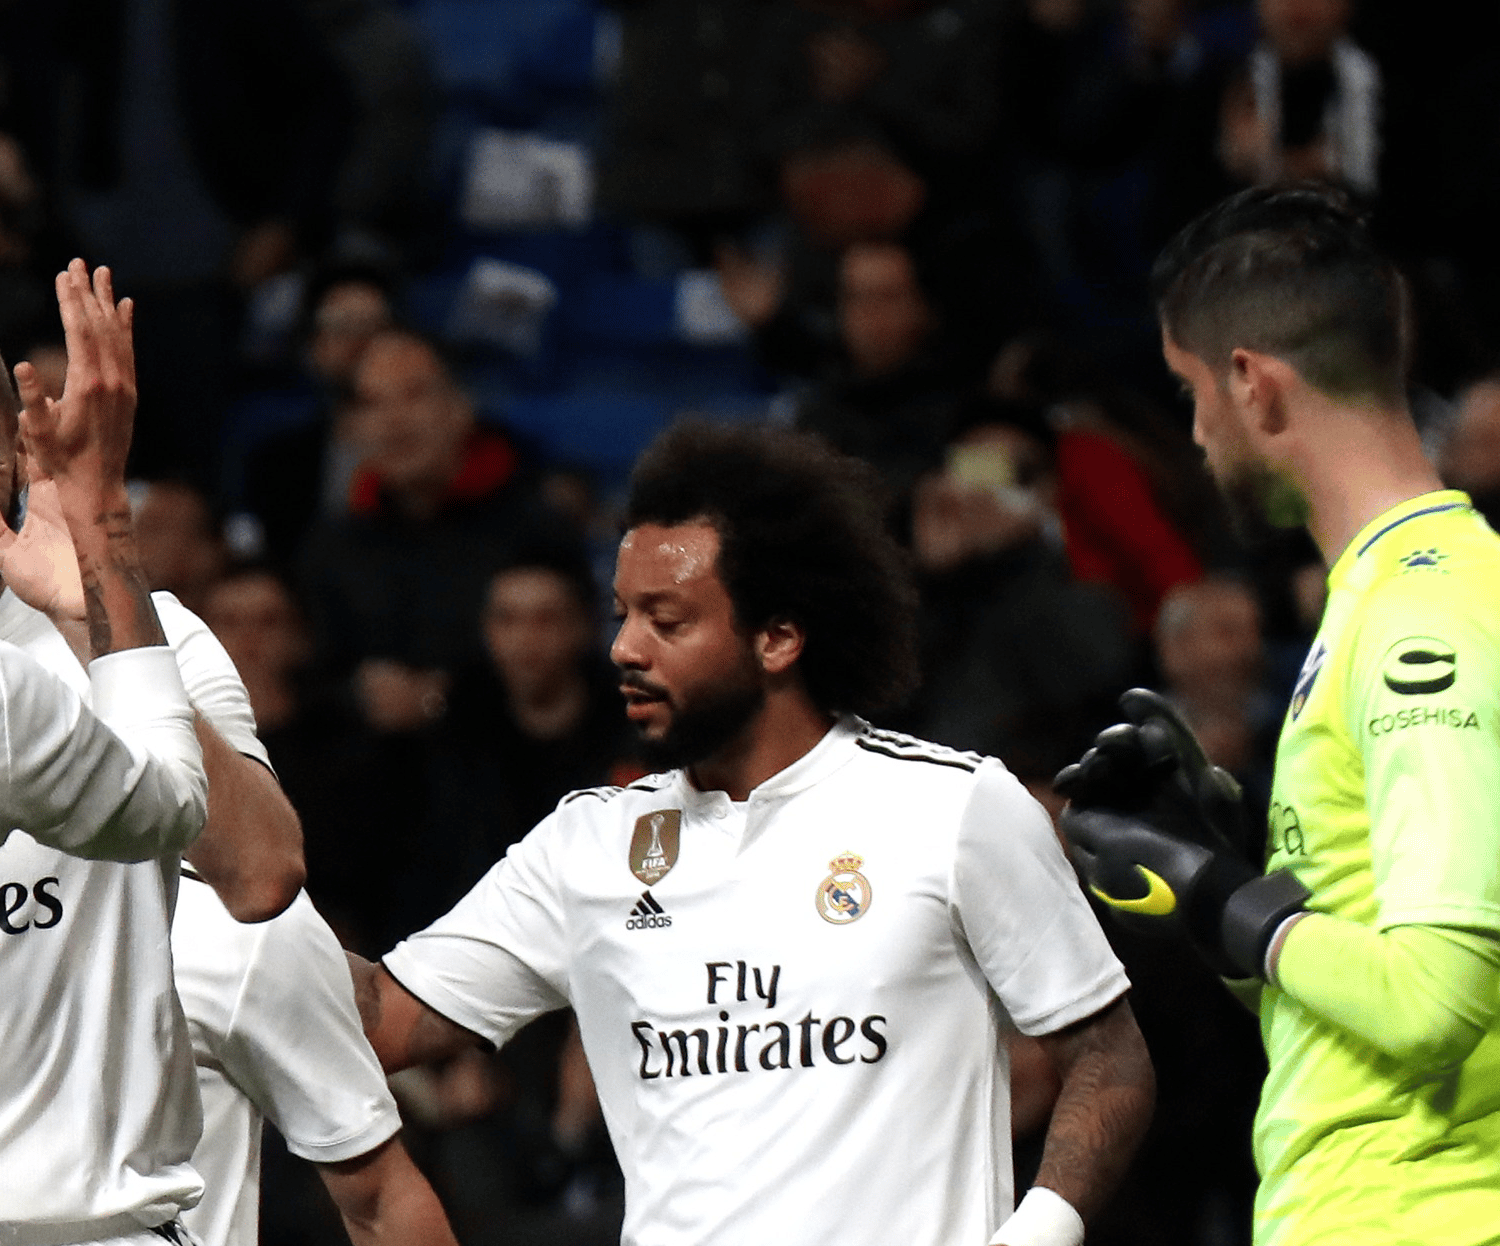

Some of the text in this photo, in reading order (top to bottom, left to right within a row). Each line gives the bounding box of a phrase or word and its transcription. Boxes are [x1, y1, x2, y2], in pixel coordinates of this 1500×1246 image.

[1368, 706, 1480, 737] COSEHISA
[626, 914, 673, 930] adidas
[705, 961, 781, 1009] Fly
[631, 1010, 888, 1079] Emirates
